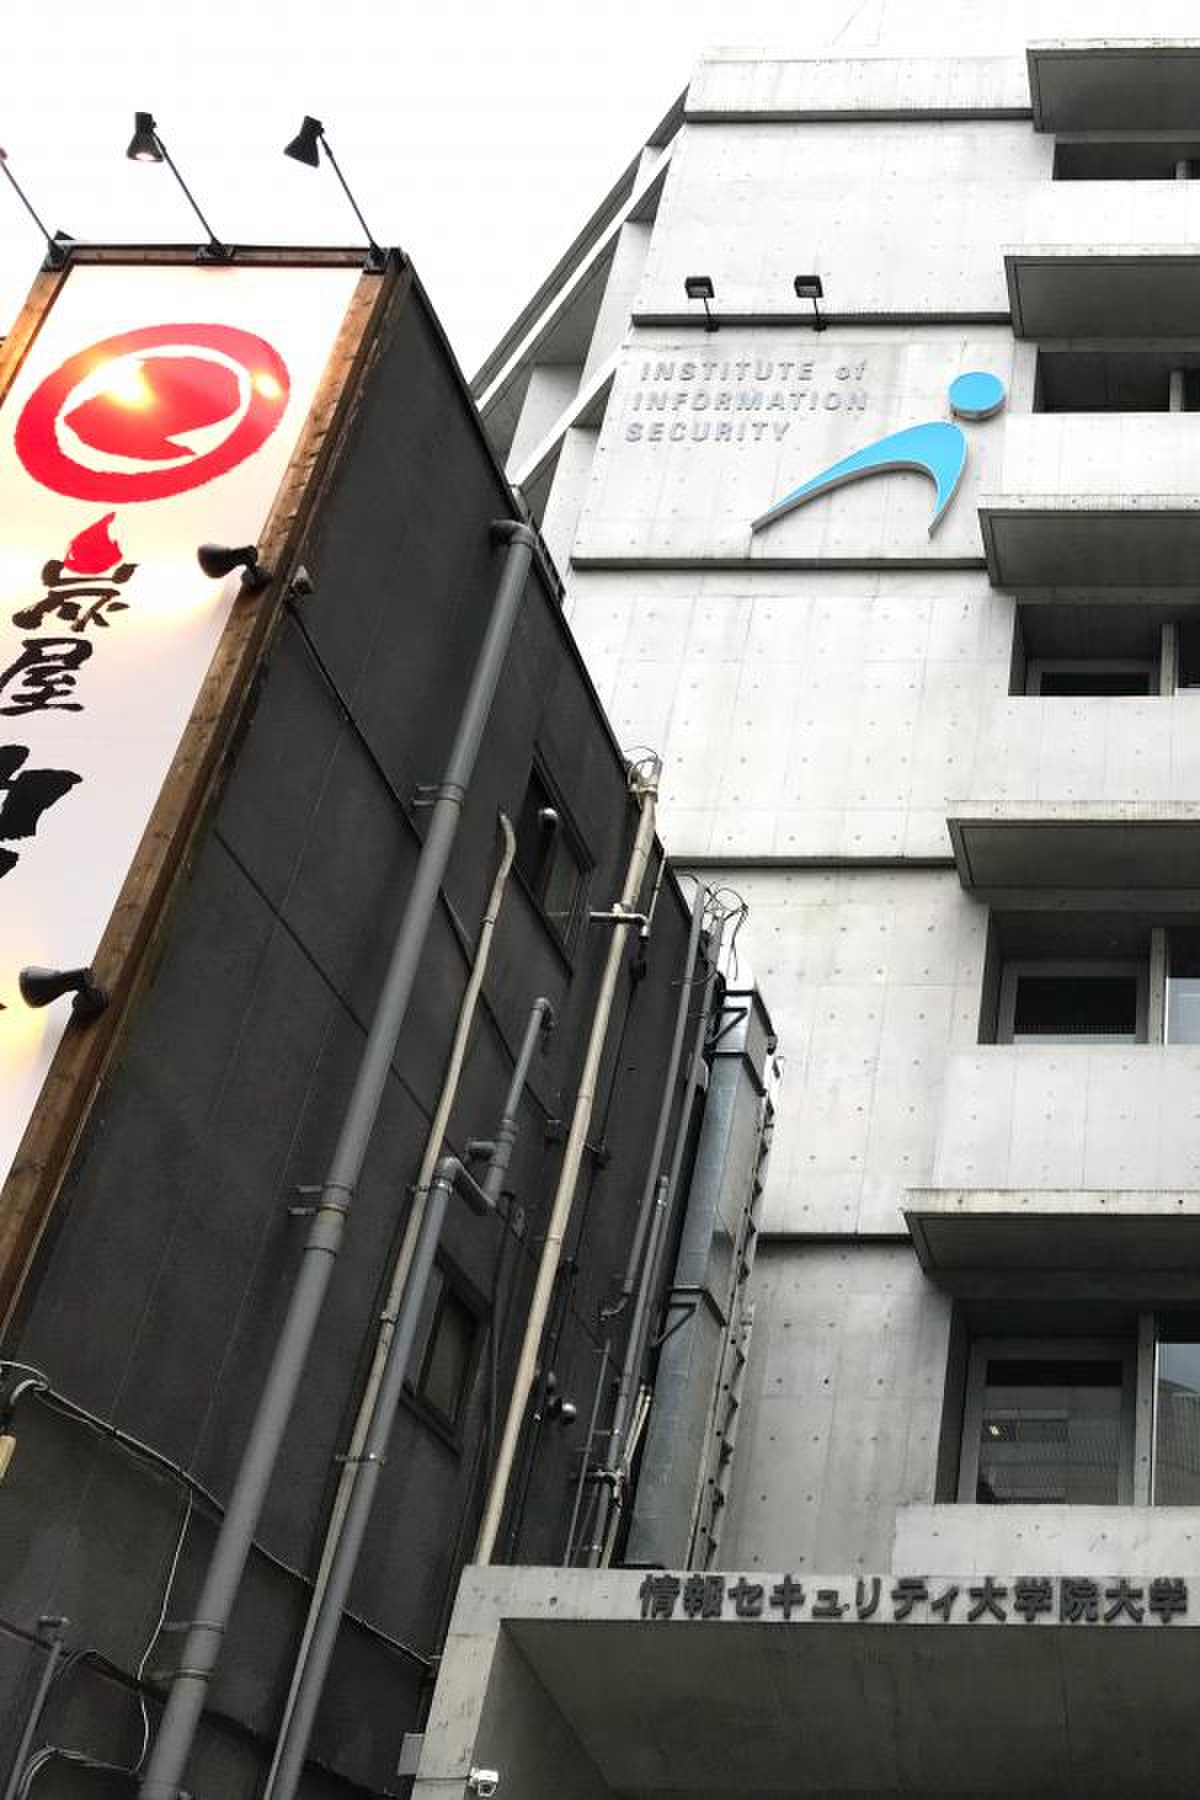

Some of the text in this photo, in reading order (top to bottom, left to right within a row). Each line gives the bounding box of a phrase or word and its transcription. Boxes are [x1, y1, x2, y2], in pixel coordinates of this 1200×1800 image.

[641, 360, 867, 381] INSTITUTE of
[631, 391, 867, 412] INFORMATION
[624, 421, 790, 442] SECURITY
[639, 1574, 1189, 1623] 情報セキュリティ大学院大学
